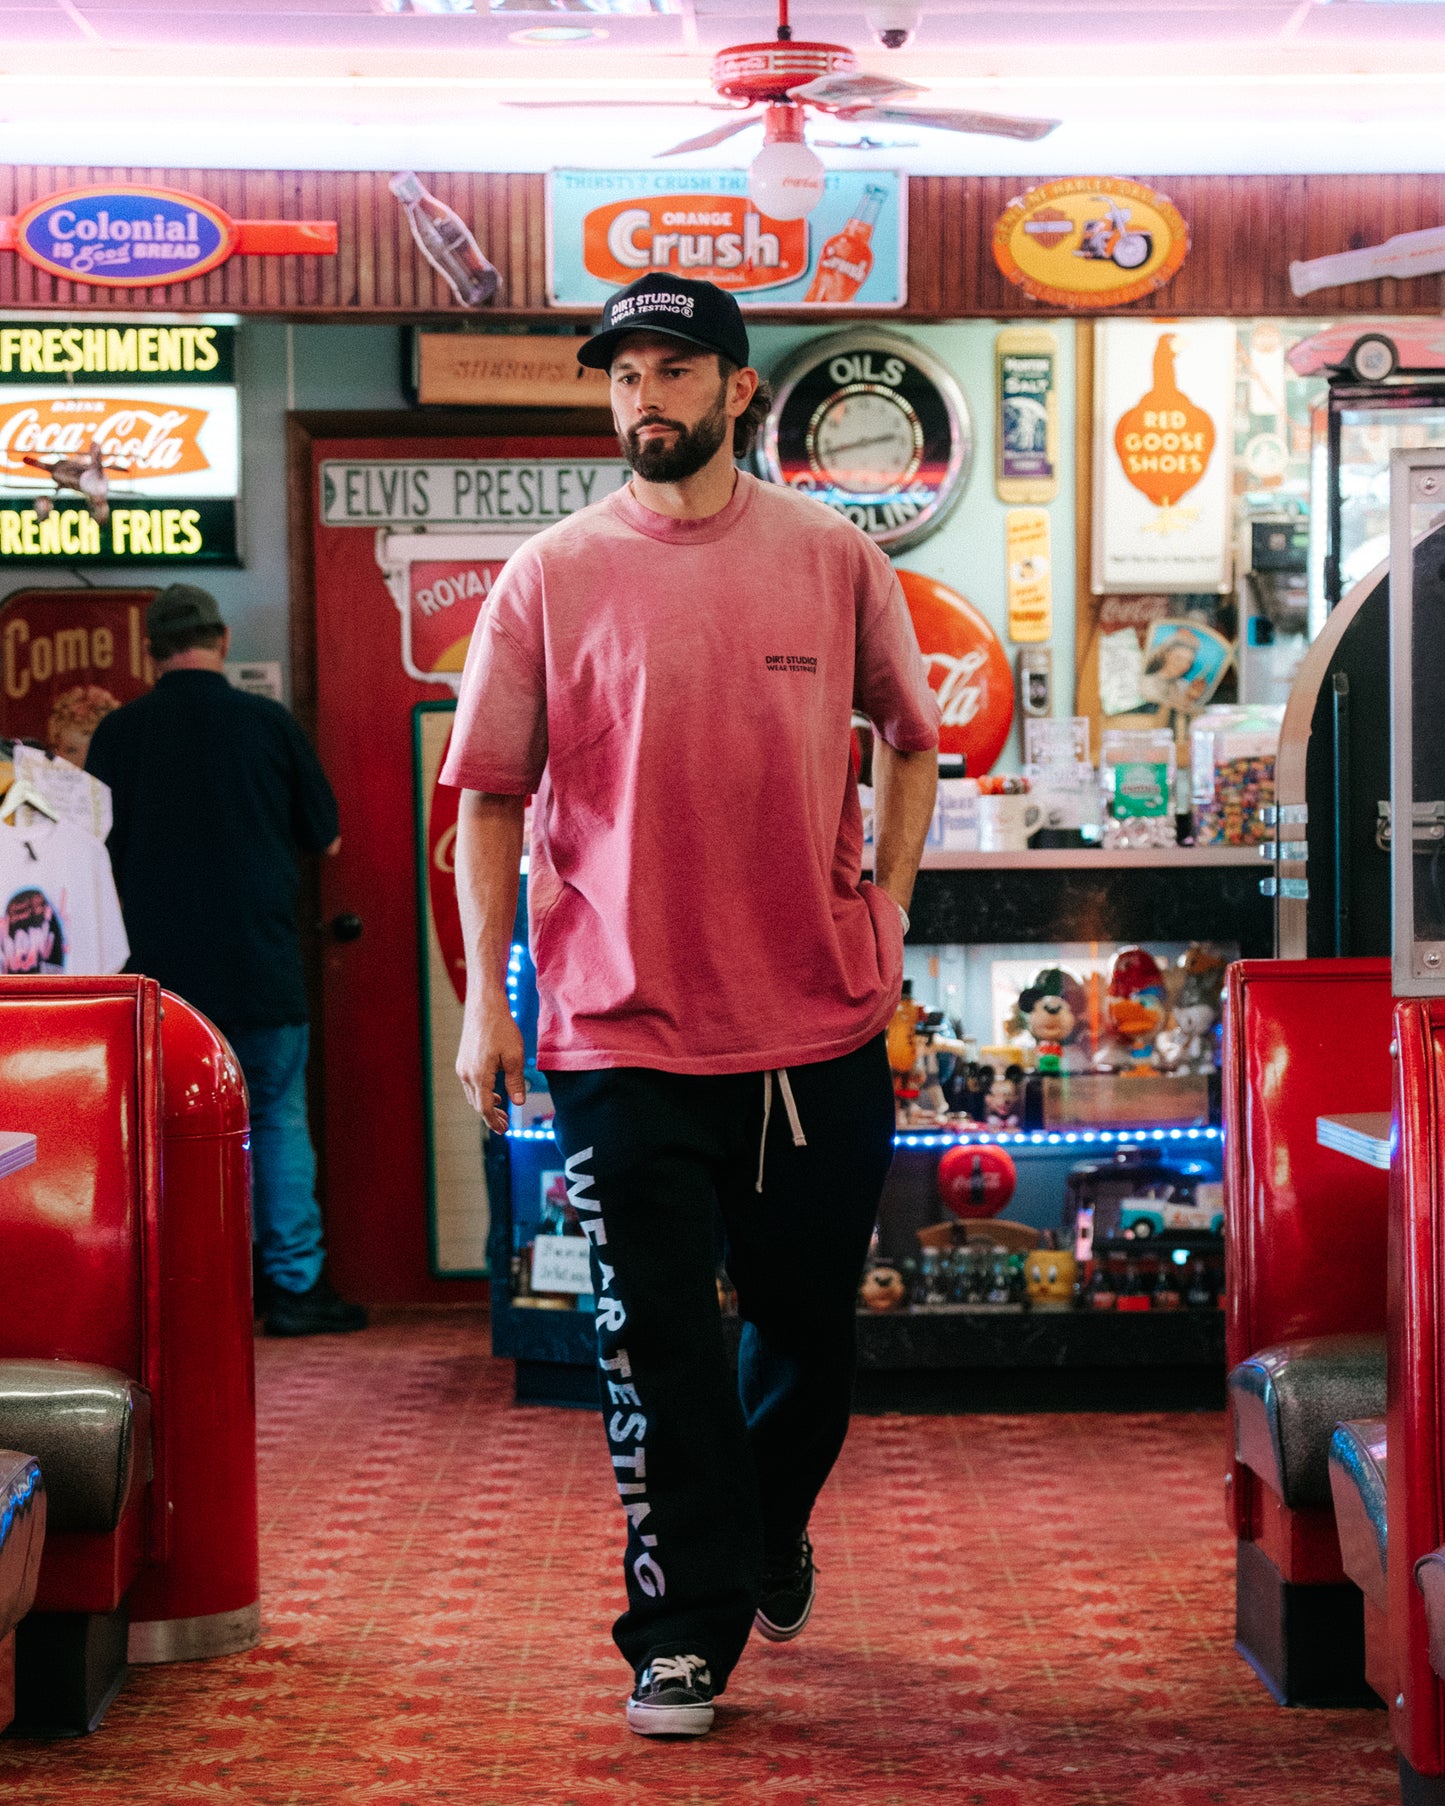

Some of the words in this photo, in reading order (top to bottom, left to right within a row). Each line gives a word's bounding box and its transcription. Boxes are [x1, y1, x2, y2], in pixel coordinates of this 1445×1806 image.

[653, 176, 711, 189] CRUSH
[719, 176, 748, 189] TH
[49, 209, 199, 242] Colonial
[662, 211, 732, 226] ORANGE
[53, 242, 75, 259] IS
[132, 242, 201, 259] BREAD
[607, 208, 780, 269] Crush
[611, 307, 636, 326] WEAR
[612, 297, 636, 317] DIRT
[636, 293, 695, 309] STUDIOS
[0, 327, 219, 373] FRESHMENTS
[829, 354, 906, 387] OILS
[51, 401, 106, 413] DRINK
[1143, 410, 1187, 430] RED
[0, 408, 189, 469] Coca-Cola
[1124, 431, 1205, 453] GOOSE
[1127, 454, 1203, 475] SHOES
[345, 469, 430, 516] ELVIS
[454, 468, 599, 516] PRESLEY
[112, 509, 203, 555] FRIES
[4, 617, 114, 699] Come
[765, 655, 784, 665] DIRT
[564, 1146, 627, 1333] WEAR
[599, 1347, 666, 1599] TESTING
